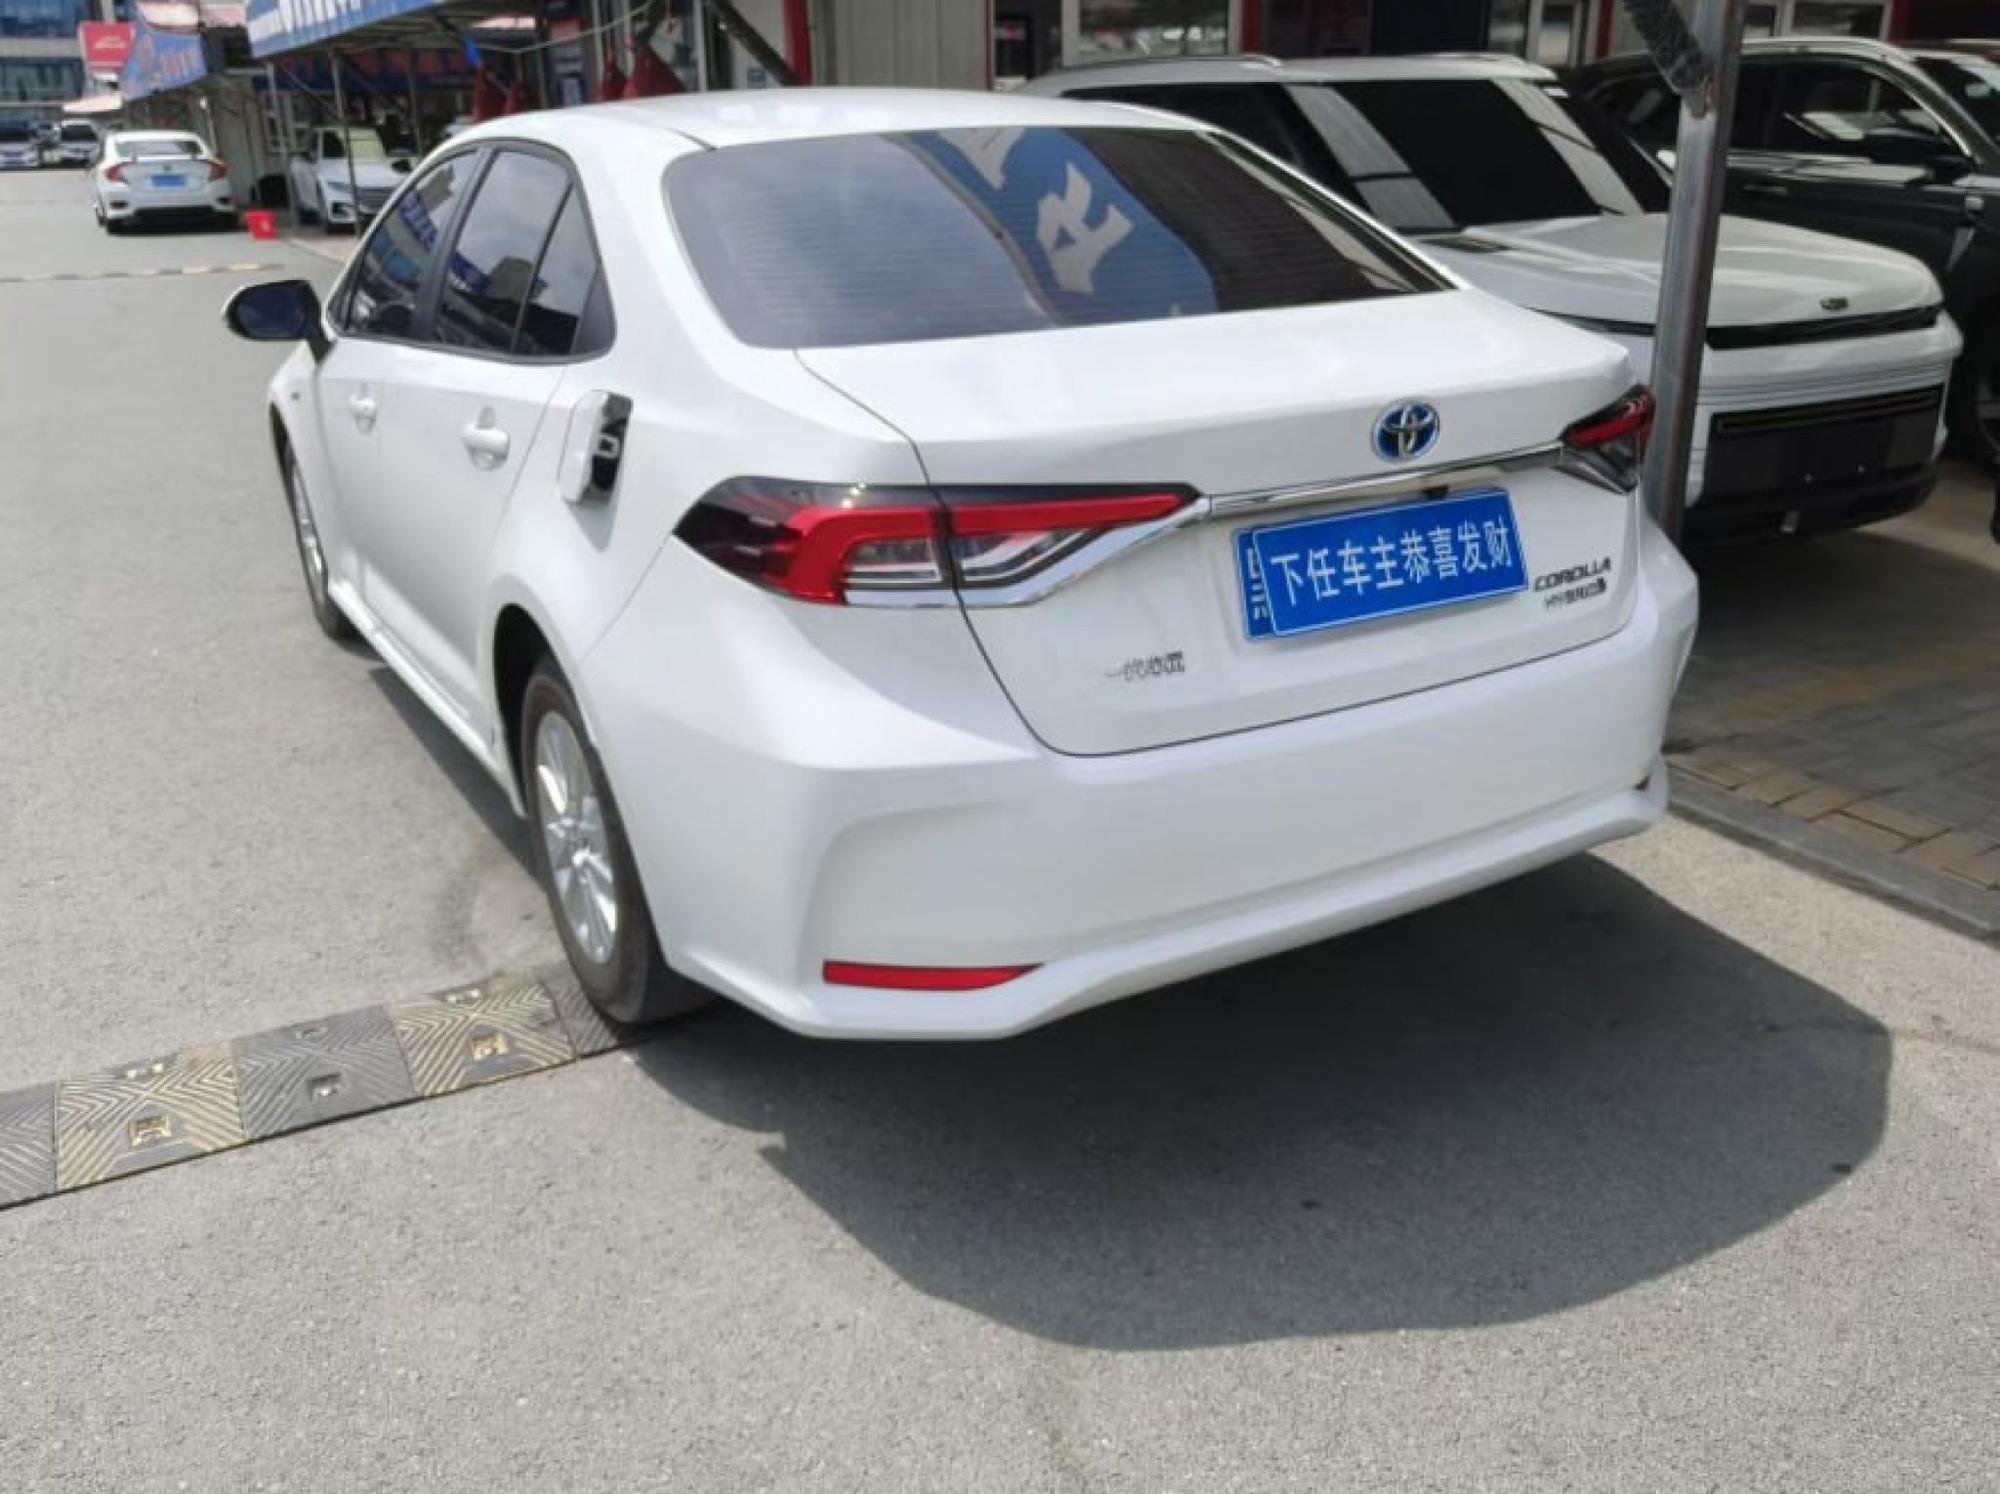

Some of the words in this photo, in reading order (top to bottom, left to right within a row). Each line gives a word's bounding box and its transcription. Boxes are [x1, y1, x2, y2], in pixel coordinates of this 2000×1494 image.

[1270, 514, 1513, 606] 下任车主恭喜发财
[1534, 556, 1611, 590] COROLLA
